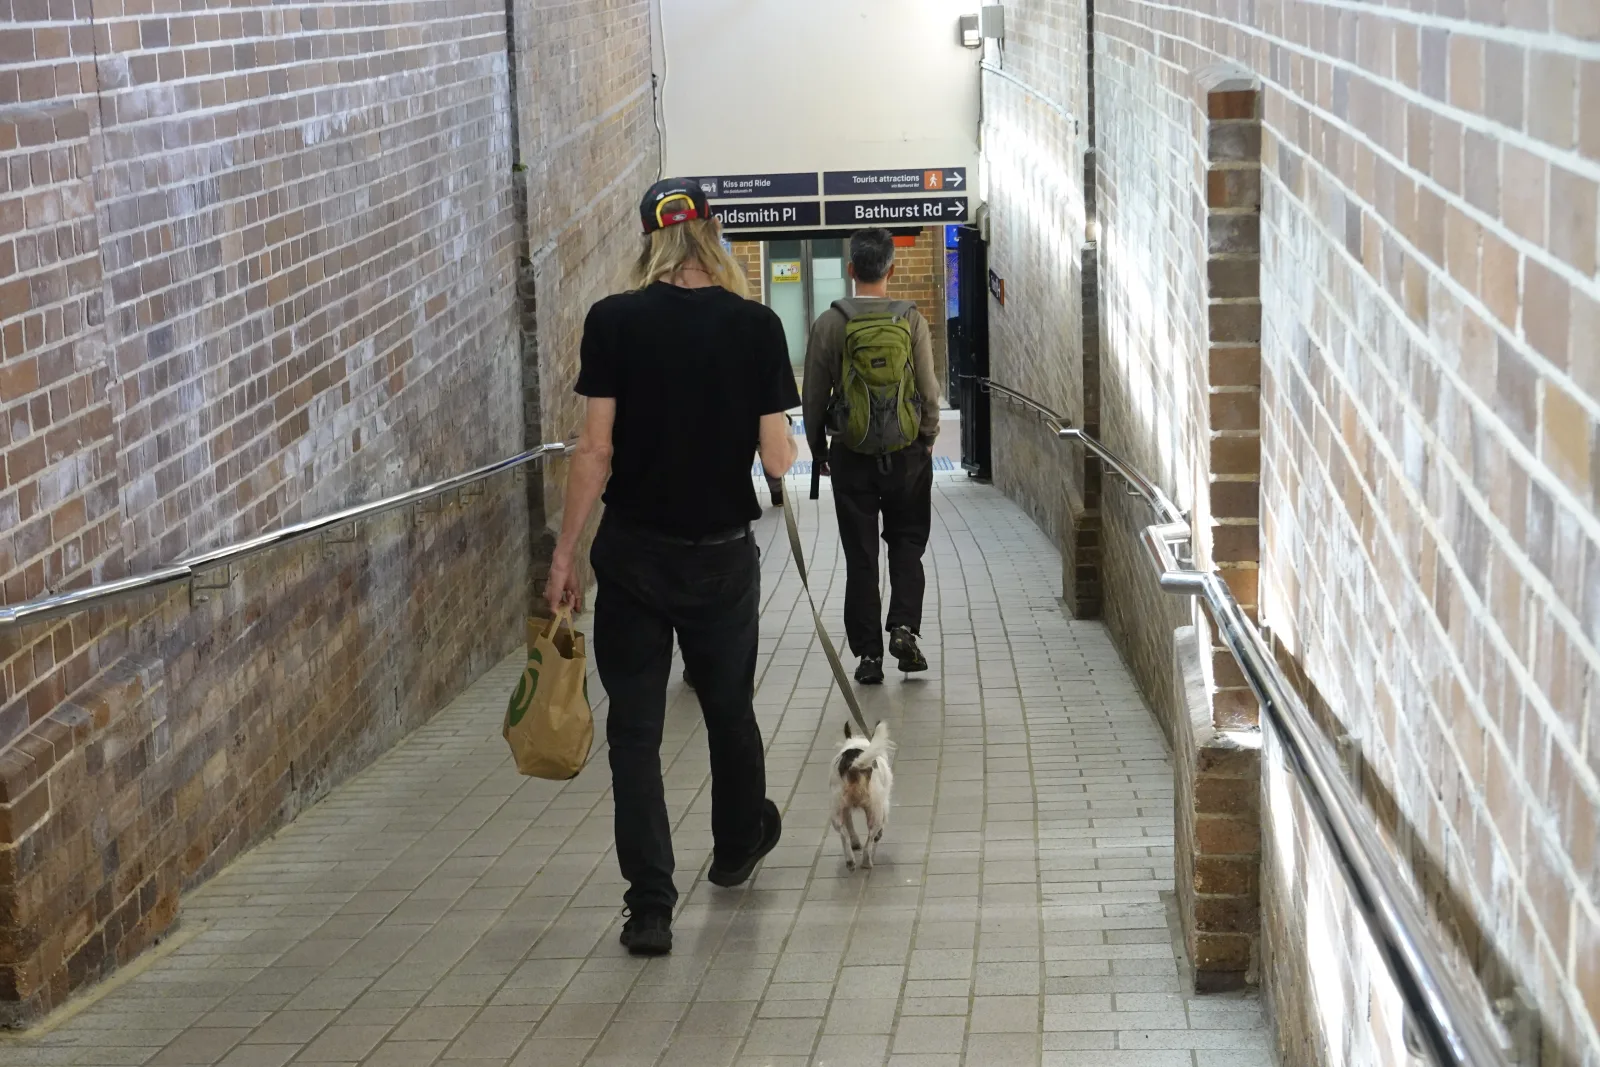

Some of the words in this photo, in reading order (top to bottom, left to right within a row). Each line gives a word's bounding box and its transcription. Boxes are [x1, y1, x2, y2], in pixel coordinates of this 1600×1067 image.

[852, 175, 878, 183] Tourist
[711, 208, 779, 223] oldsmith
[783, 207, 796, 221] Pl
[855, 204, 920, 218] Bathurst
[923, 203, 942, 216] Rd
